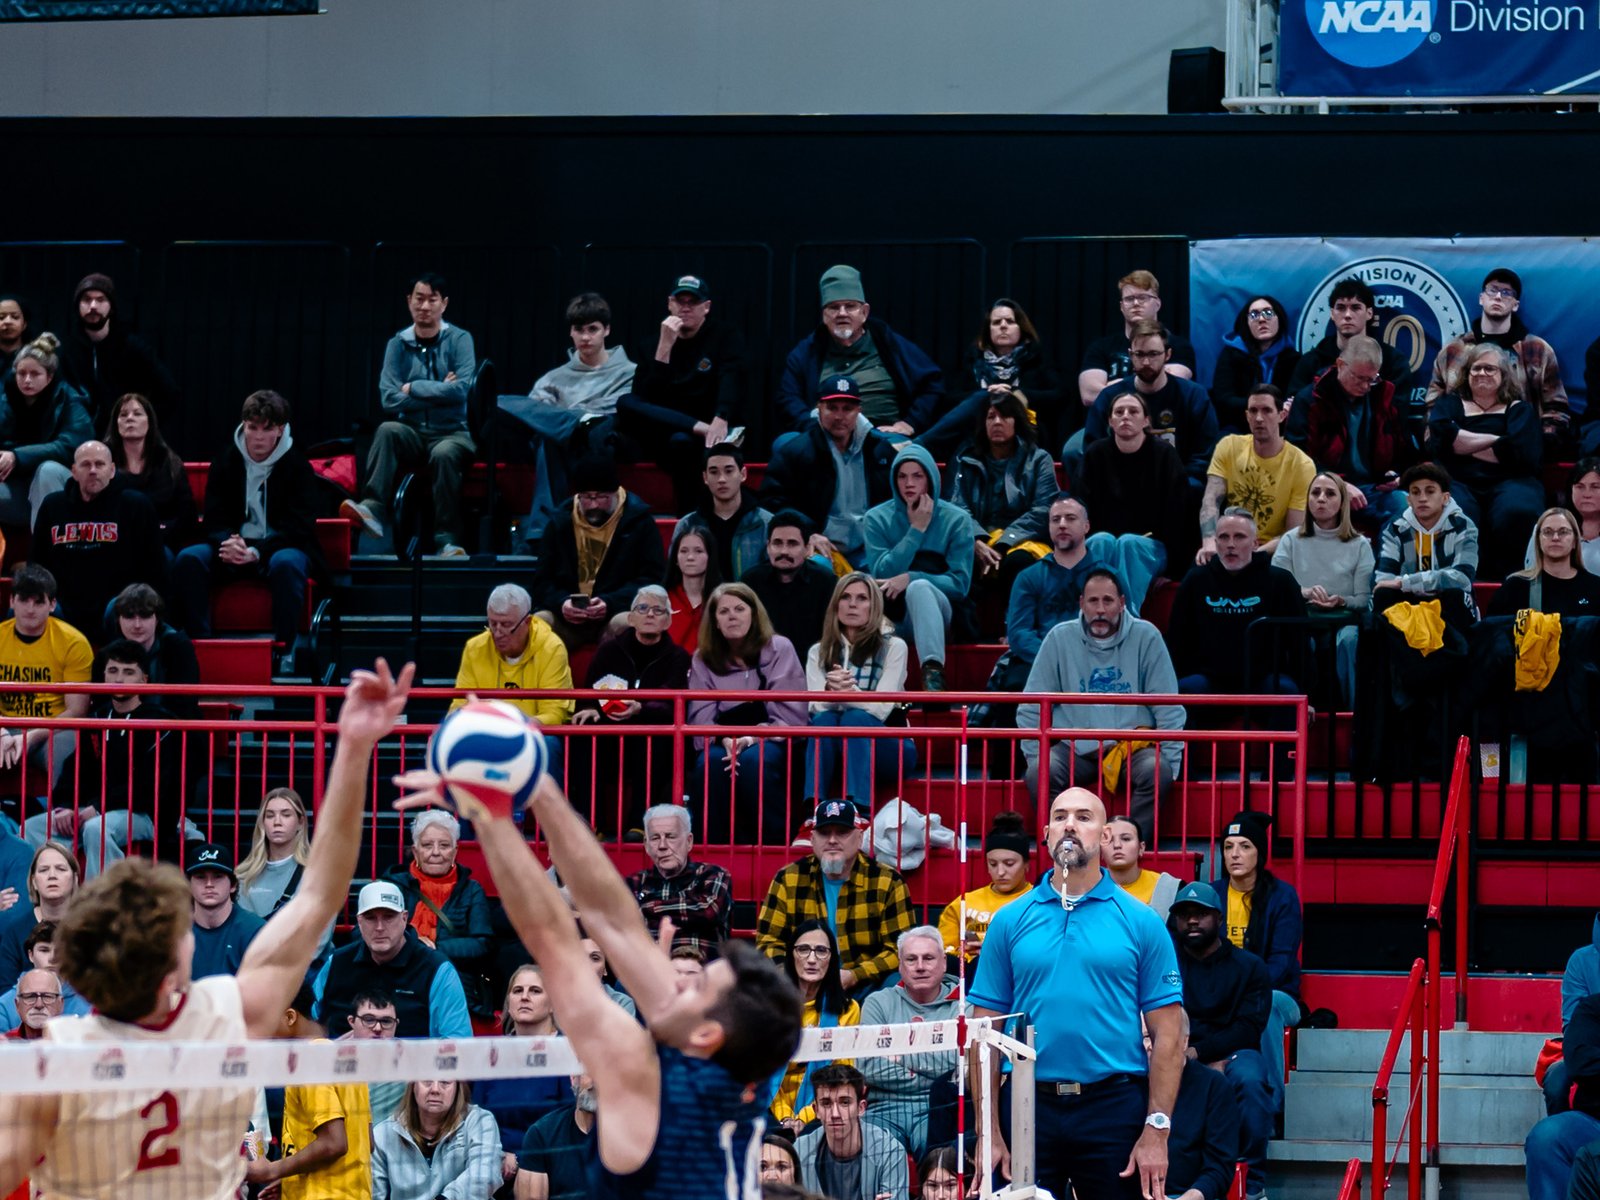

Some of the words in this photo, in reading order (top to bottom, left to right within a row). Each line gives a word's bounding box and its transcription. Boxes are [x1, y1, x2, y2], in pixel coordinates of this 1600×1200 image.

[1319, 1, 1432, 34] NCAA
[1451, 0, 1585, 32] Division
[1347, 267, 1416, 286] VISION
[1374, 294, 1405, 308] CAA
[51, 522, 118, 545] LEWIS
[137, 1090, 179, 1171] 2
